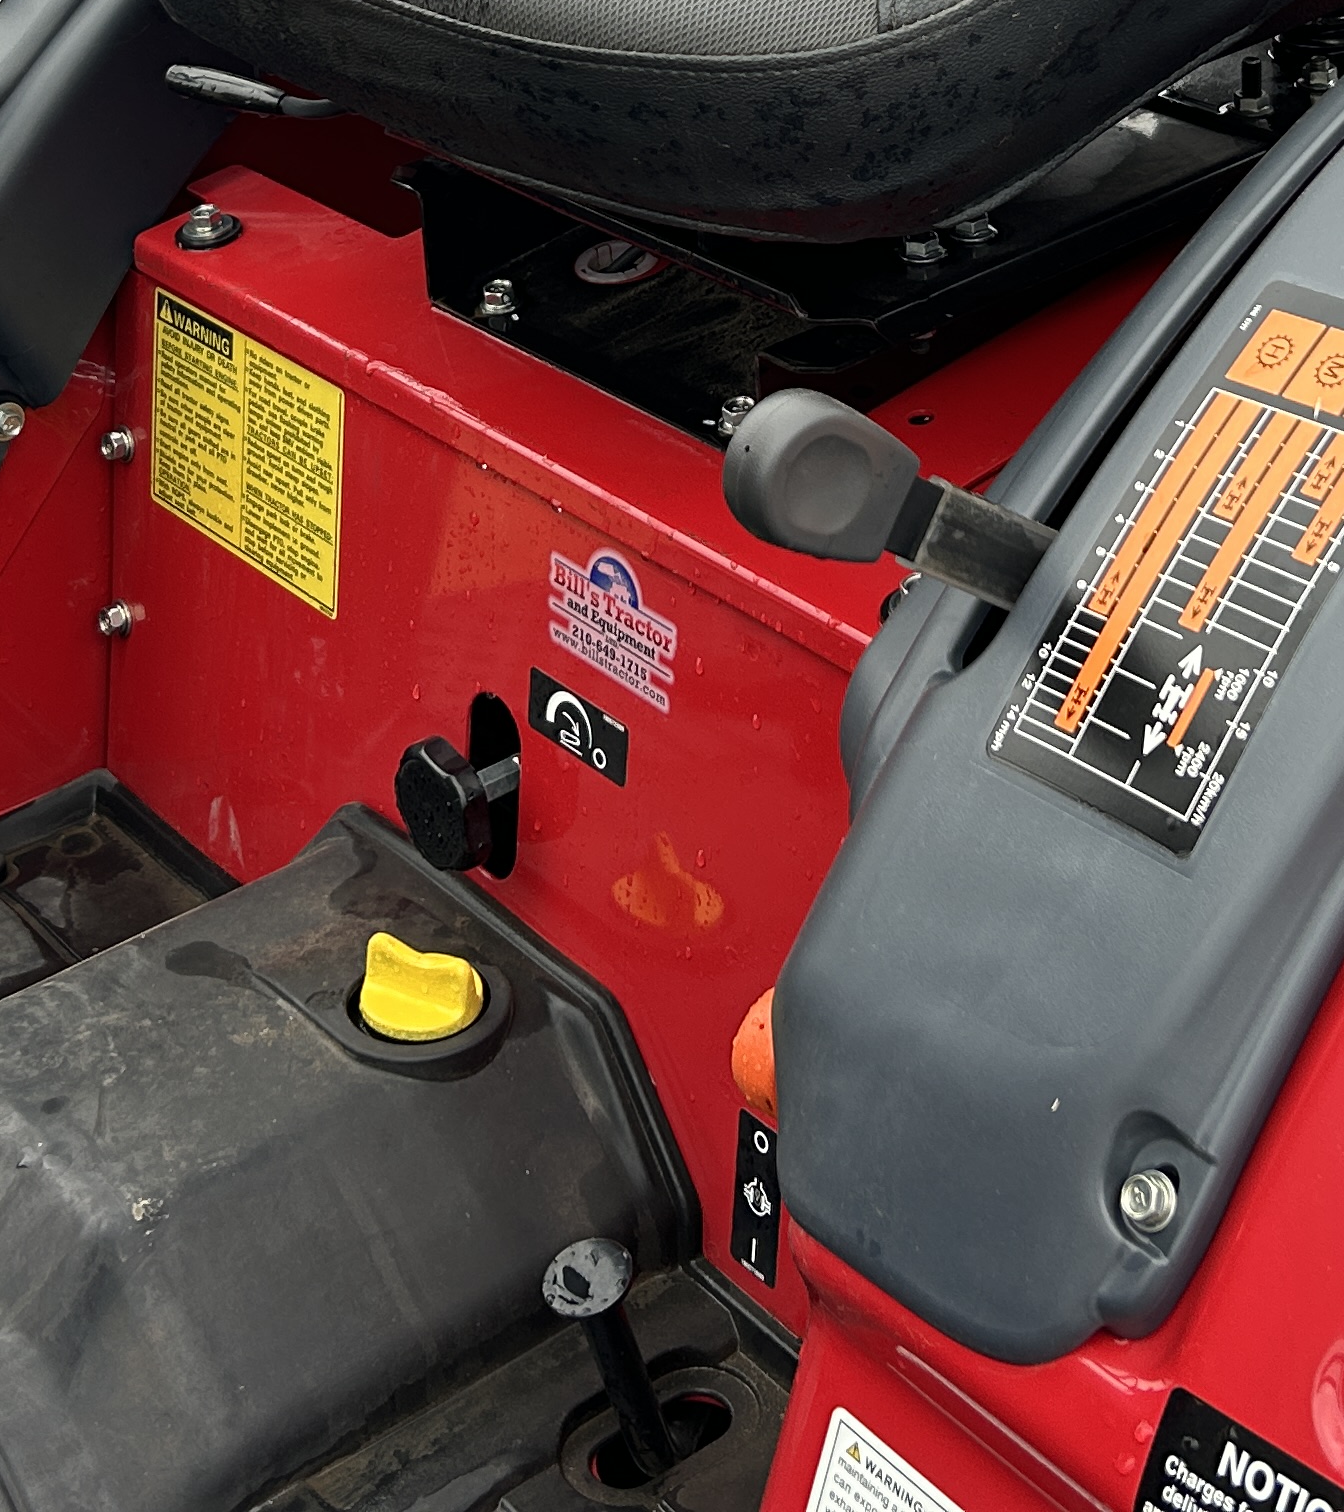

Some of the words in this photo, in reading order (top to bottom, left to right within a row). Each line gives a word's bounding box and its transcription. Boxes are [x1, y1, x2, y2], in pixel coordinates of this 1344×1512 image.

[172, 309, 231, 356] WARNING
[1265, 343, 1285, 360] H
[554, 563, 599, 609] Bill's
[603, 592, 673, 654] Tractor
[567, 596, 589, 618] and
[591, 610, 657, 661] Equipment
[572, 624, 648, 682] 210-649-1715
[1038, 641, 1053, 659] 10
[552, 626, 666, 707] www.billstractor.com
[1021, 672, 1036, 691] 12
[1262, 670, 1279, 689] 10
[1213, 670, 1235, 701] rpm
[1006, 703, 1021, 721] 14
[990, 719, 1011, 752] mph
[1235, 721, 1251, 741] 15
[1174, 746, 1195, 777] rpm
[833, 1473, 852, 1495] can
[838, 1455, 890, 1510] maintaining
[1164, 1454, 1236, 1512] Charges
